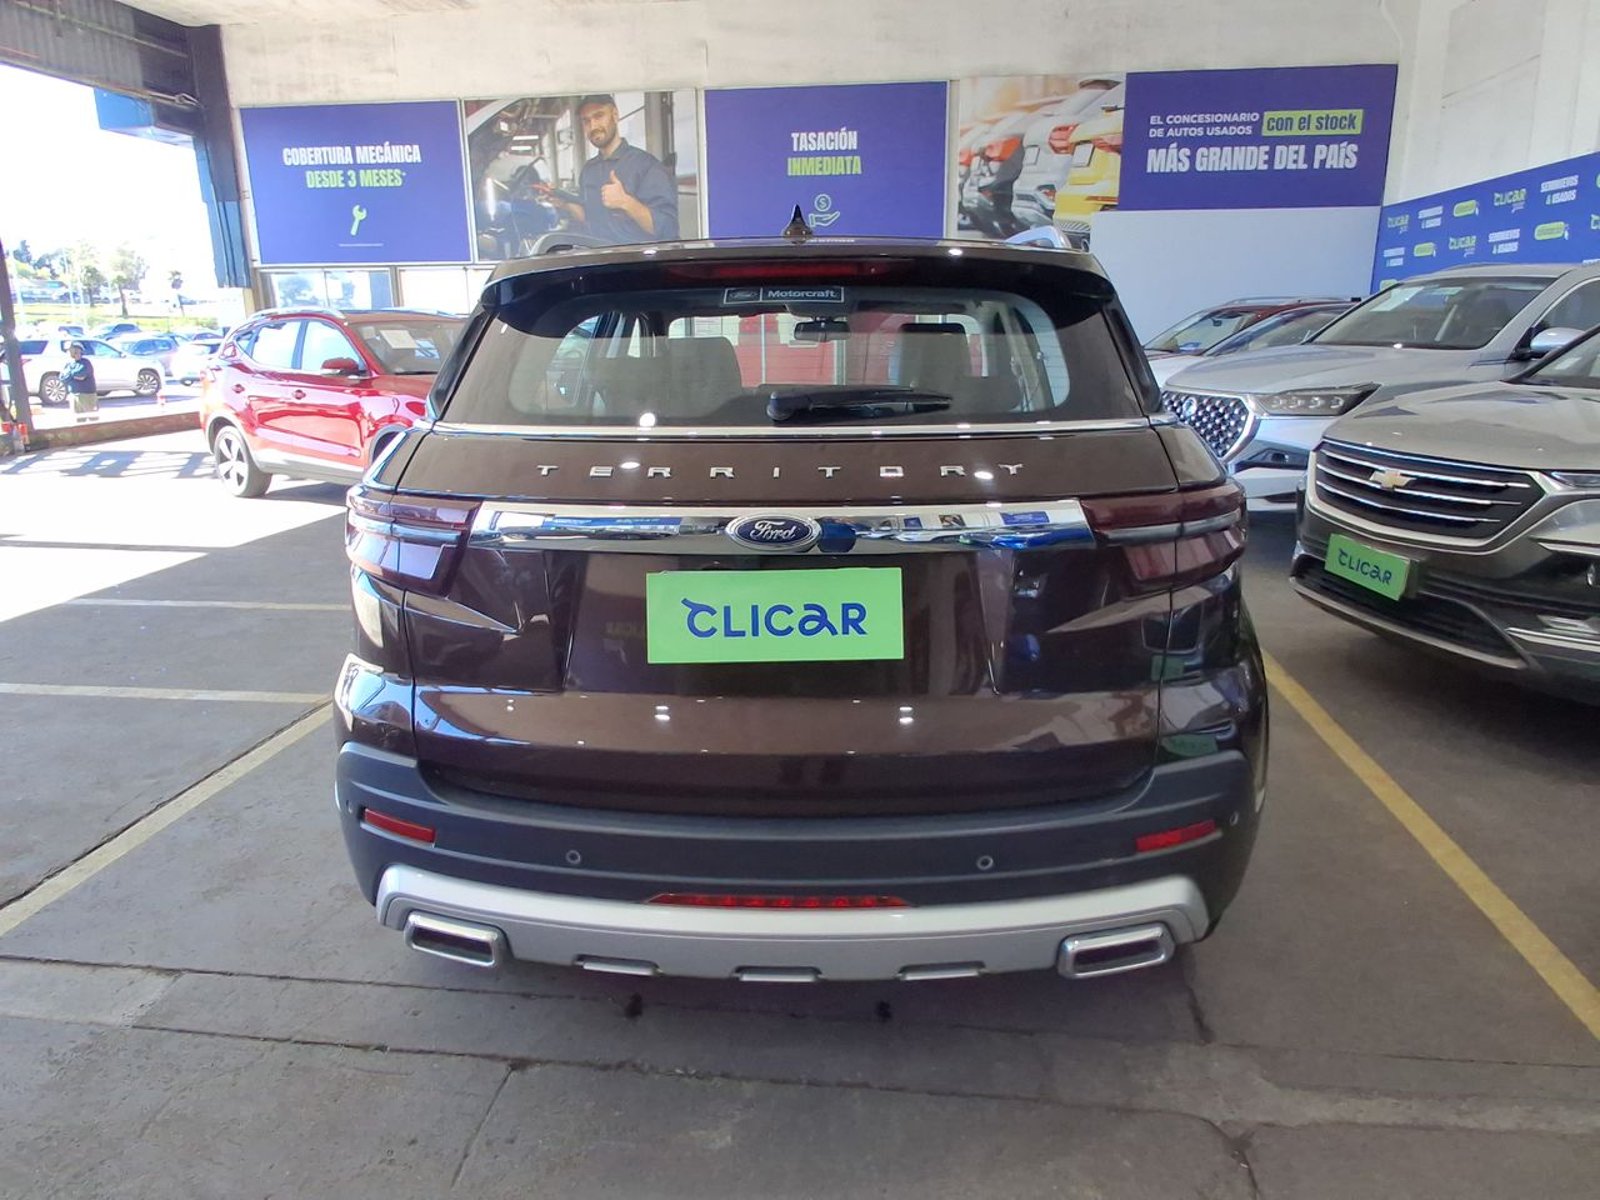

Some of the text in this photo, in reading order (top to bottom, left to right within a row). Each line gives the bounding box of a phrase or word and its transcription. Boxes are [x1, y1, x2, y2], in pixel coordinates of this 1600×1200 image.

[1150, 112, 1260, 125] EL CONCESIONARIO
[1266, 112, 1357, 132] con el stock
[791, 126, 858, 152] TASACIÓN
[1149, 126, 1253, 137] DE AUTOS USADOS
[282, 141, 422, 166] COBERTURA MECÁNICA
[1146, 142, 1190, 173] MÁS
[1195, 146, 1268, 172] GRANDE
[1273, 144, 1308, 170] DEL
[305, 170, 346, 188] DESDE
[347, 170, 357, 188] 3
[768, 289, 834, 298] Motorcraft
[537, 463, 1024, 479] TERRITORY
[749, 520, 798, 540] Ford
